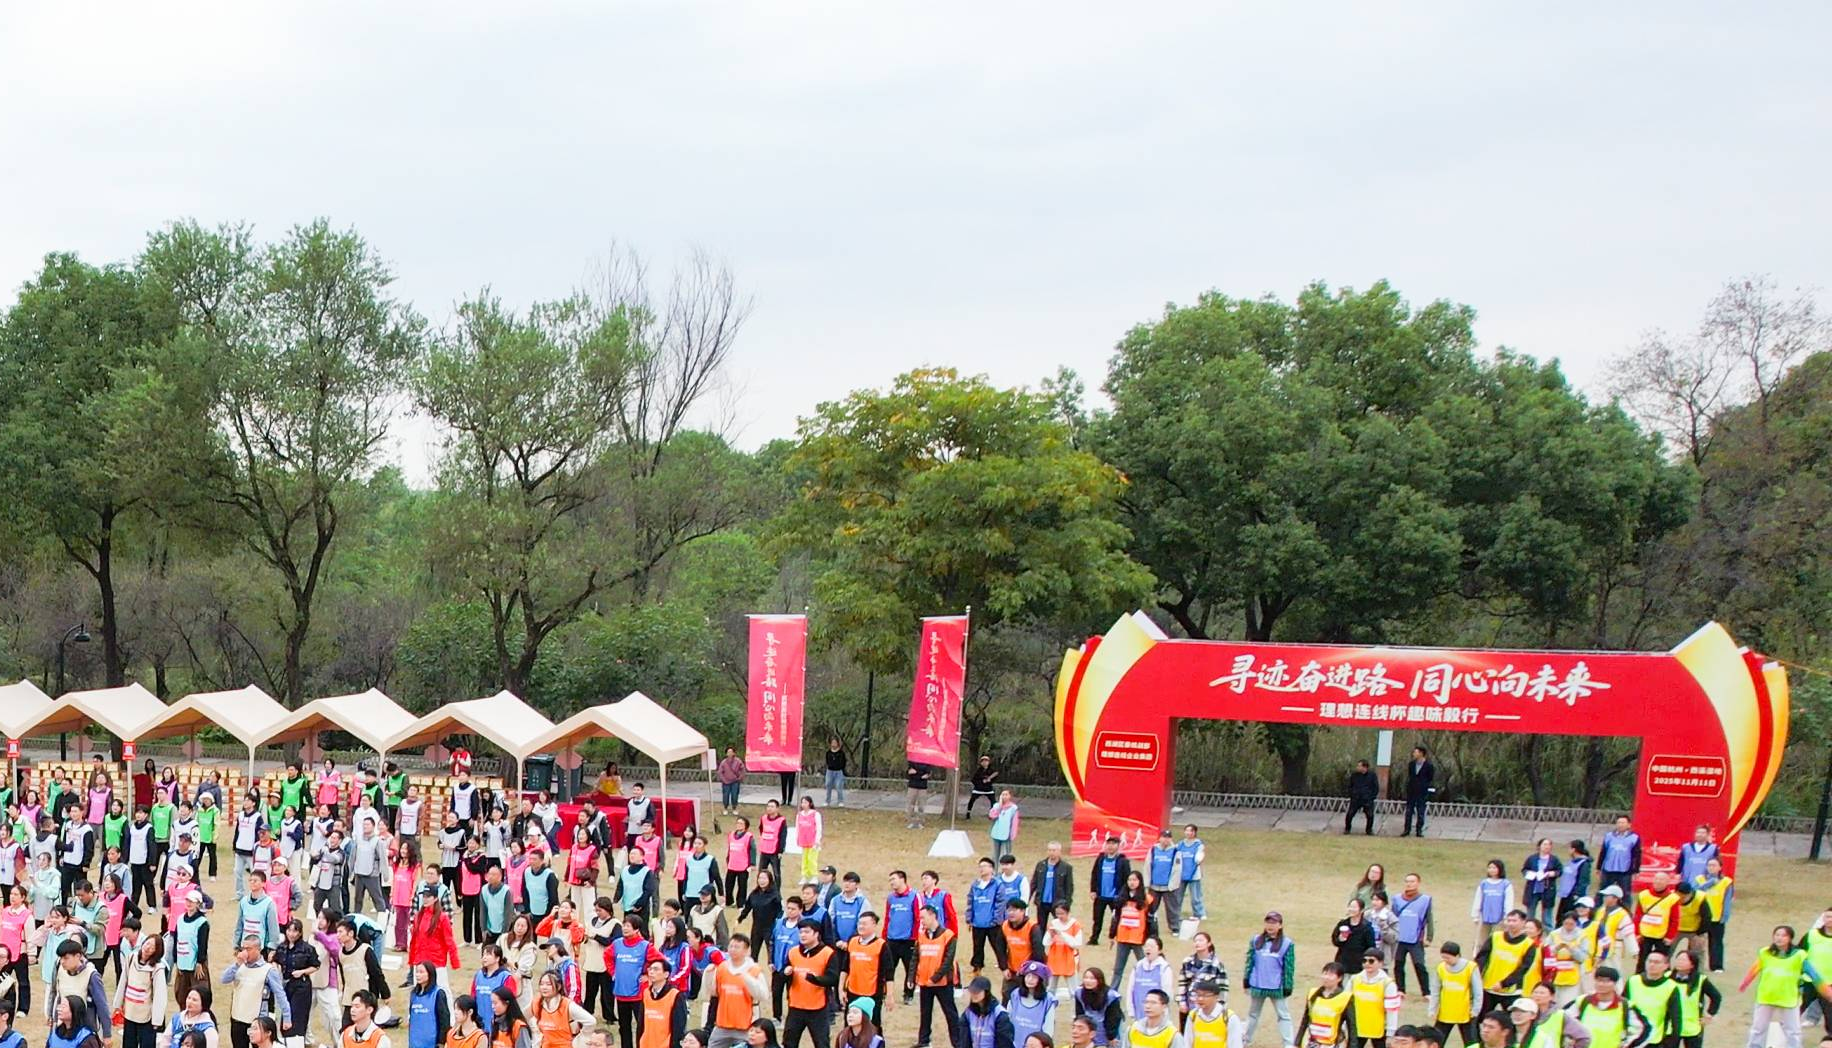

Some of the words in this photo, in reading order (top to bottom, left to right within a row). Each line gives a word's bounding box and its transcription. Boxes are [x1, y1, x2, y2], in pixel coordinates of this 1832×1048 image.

[1210, 654, 1404, 694] 寻迹奋进路
[1410, 661, 1611, 705] 同心向未来
[1319, 702, 1479, 724] 理想连线杯趣味毅行
[1654, 777, 1717, 787] 2025年11月11日
